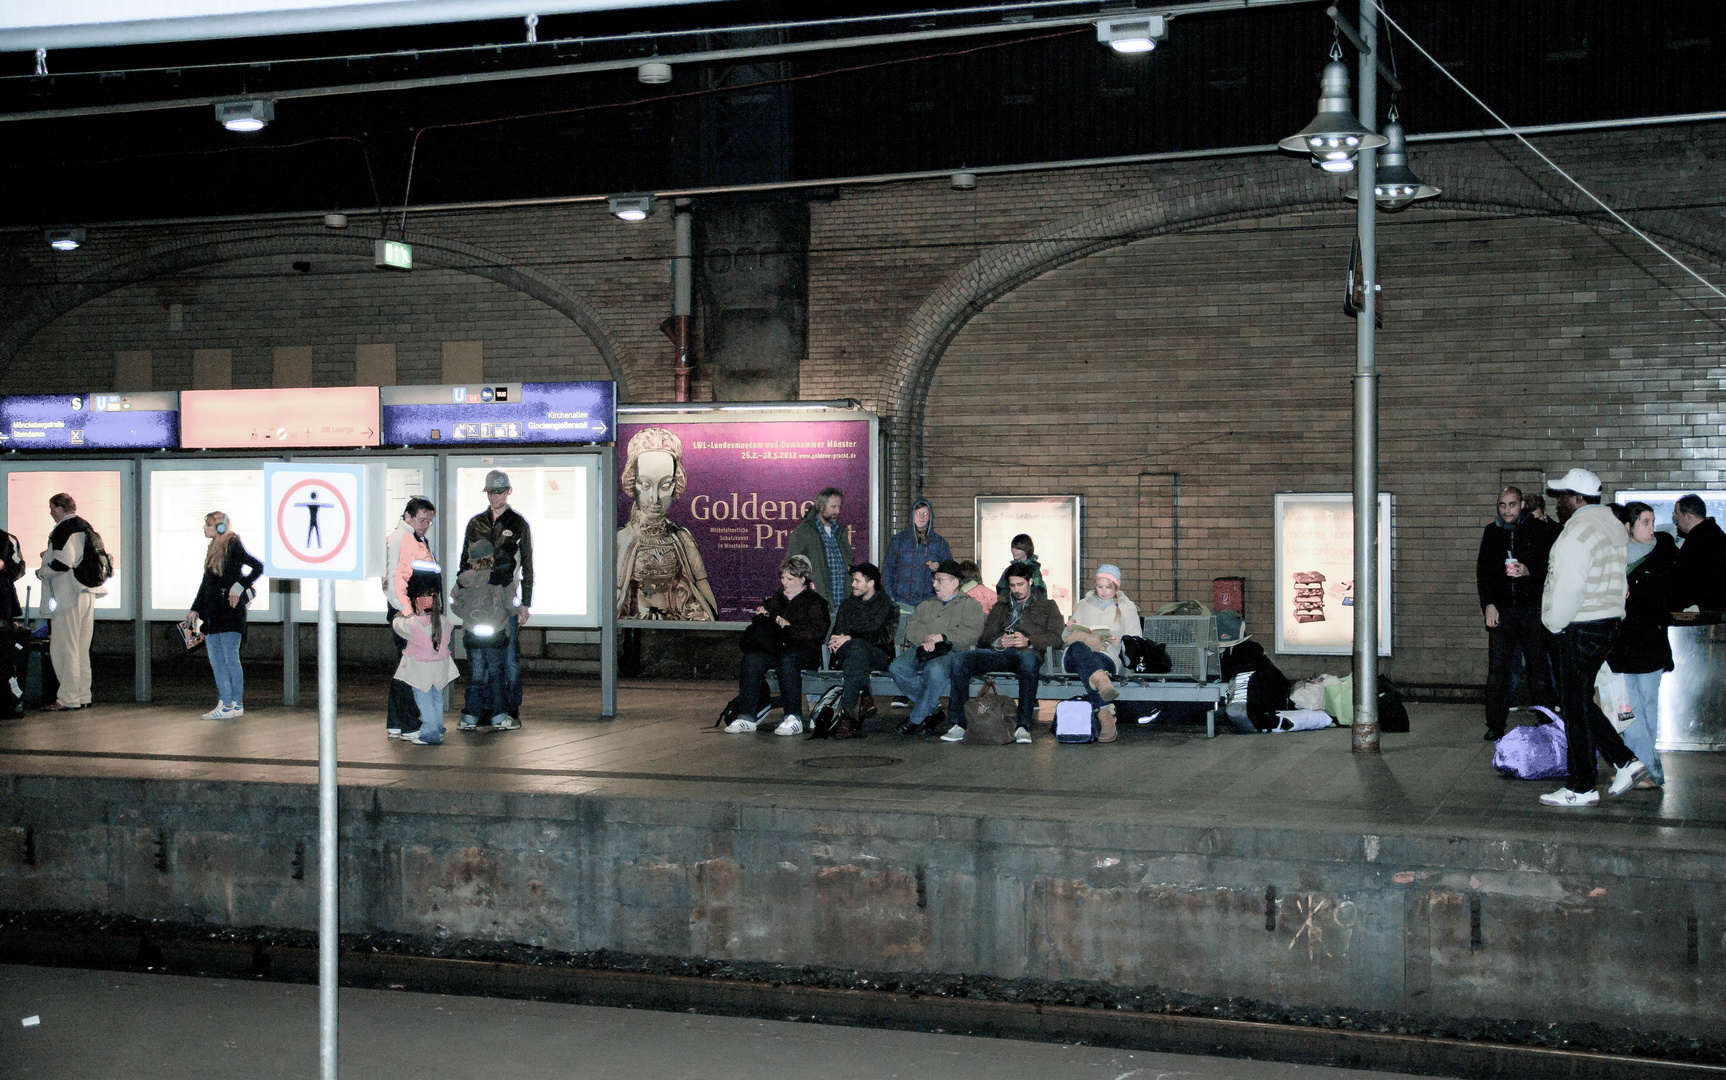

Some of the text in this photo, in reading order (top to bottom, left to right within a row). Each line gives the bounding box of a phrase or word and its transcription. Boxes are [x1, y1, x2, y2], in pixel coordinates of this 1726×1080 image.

[454, 388, 464, 401] U
[71, 397, 83, 411] S
[97, 396, 107, 411] U
[547, 411, 589, 419] Kirchenallee
[332, 426, 355, 434] Lounge
[693, 441, 763, 449] LWL-Landesmuseum
[765, 441, 779, 449] und
[827, 440, 857, 448] Münster
